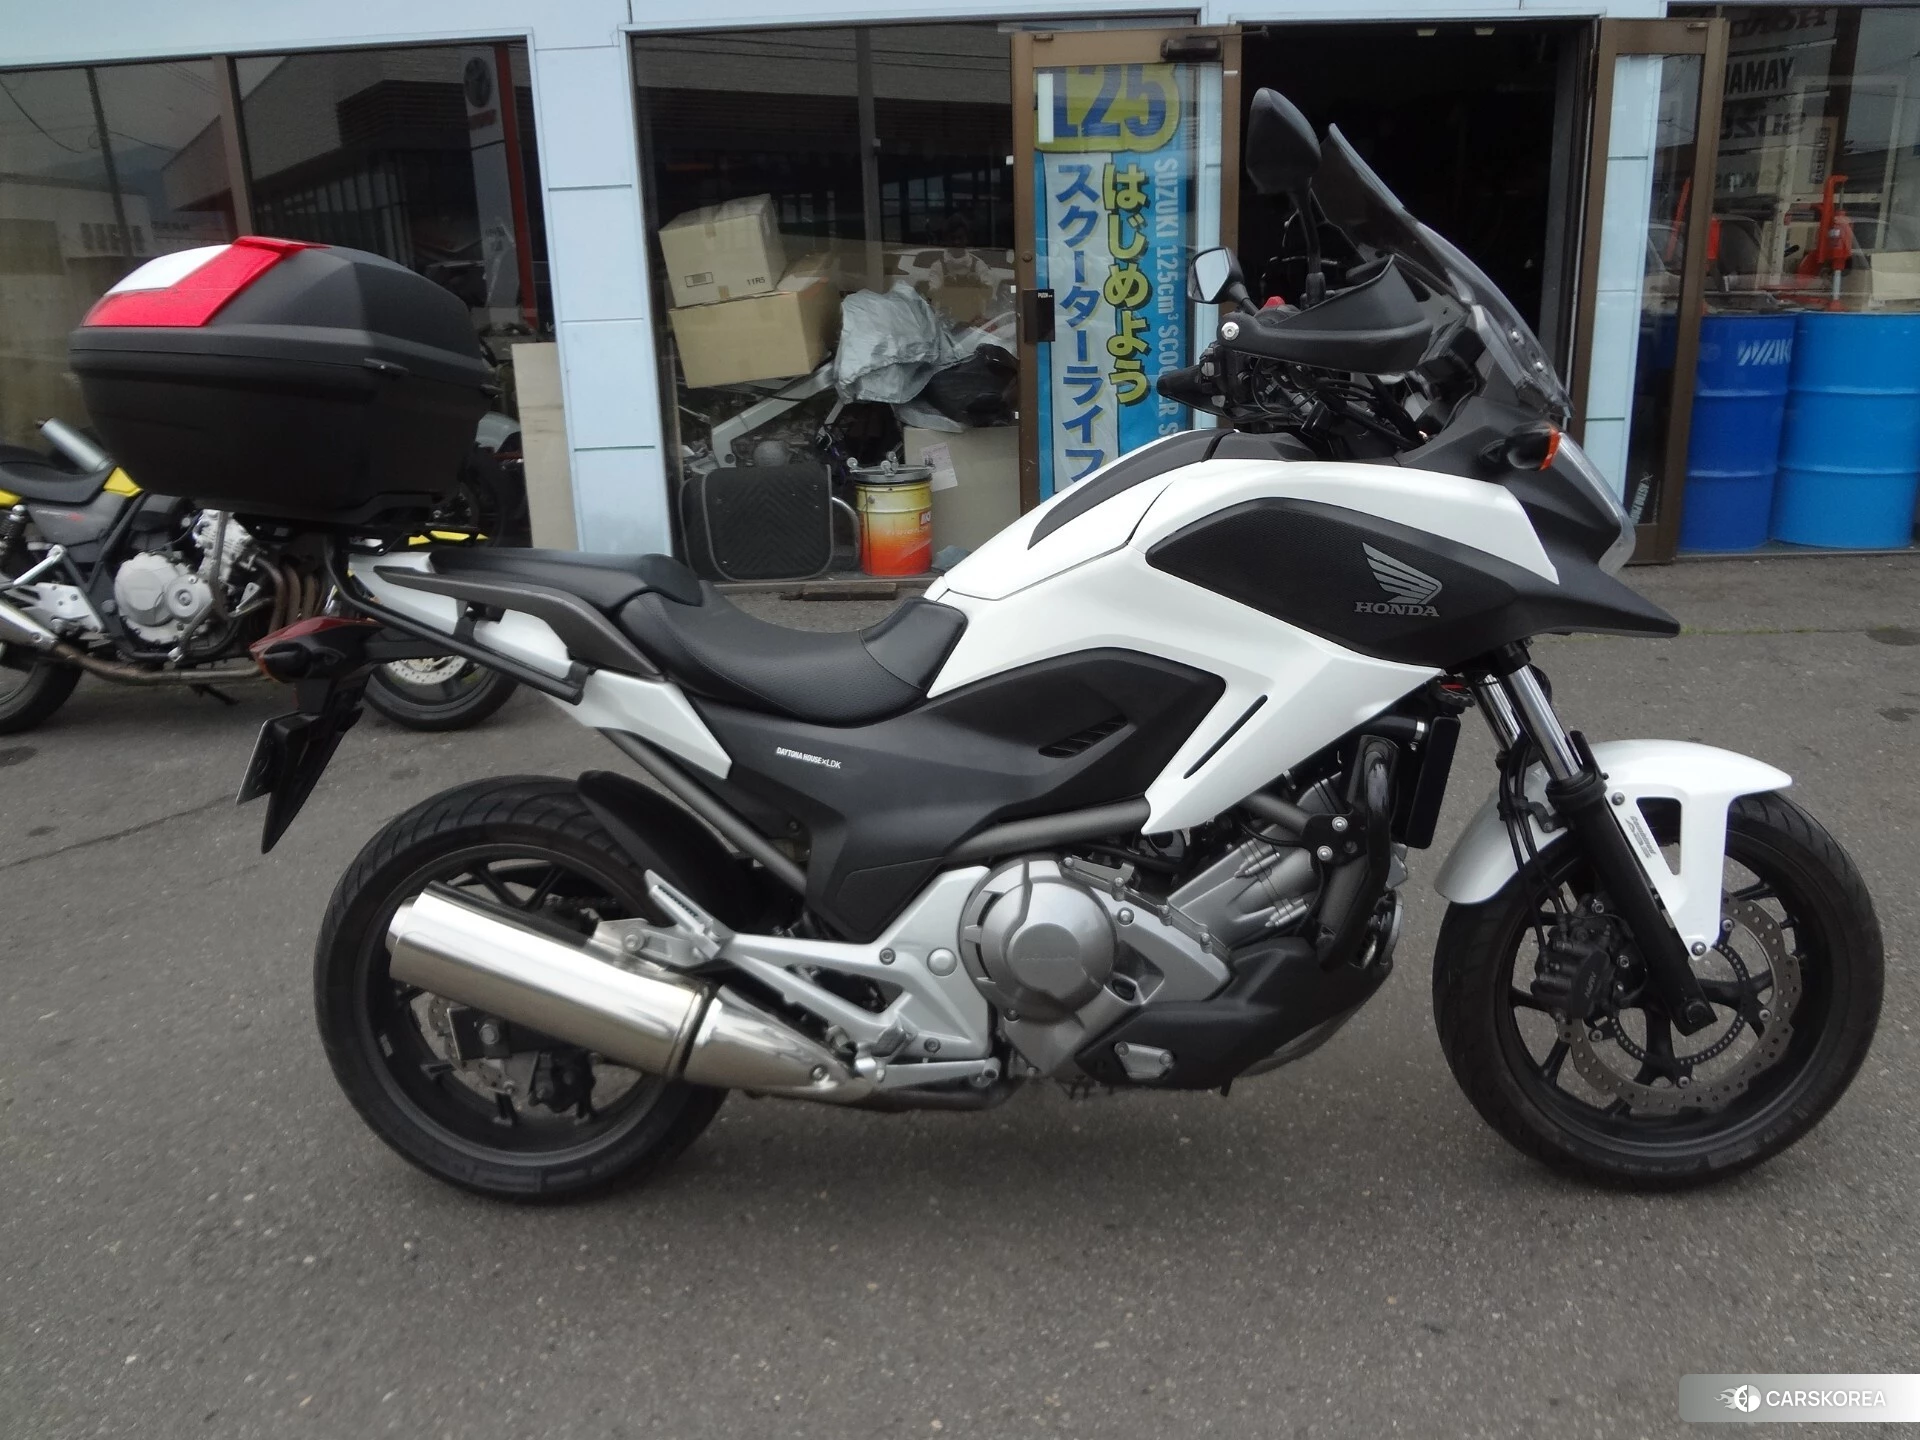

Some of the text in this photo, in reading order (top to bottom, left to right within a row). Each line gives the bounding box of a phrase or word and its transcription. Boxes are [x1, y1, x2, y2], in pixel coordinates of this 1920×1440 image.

[1037, 64, 1167, 138] 125
[1154, 157, 1179, 239] SUZUKI
[1102, 162, 1151, 405] はじめよう
[1055, 164, 1105, 482] スクーターライフ
[1354, 601, 1440, 617] HONDA
[776, 746, 802, 760] DAYTONA
